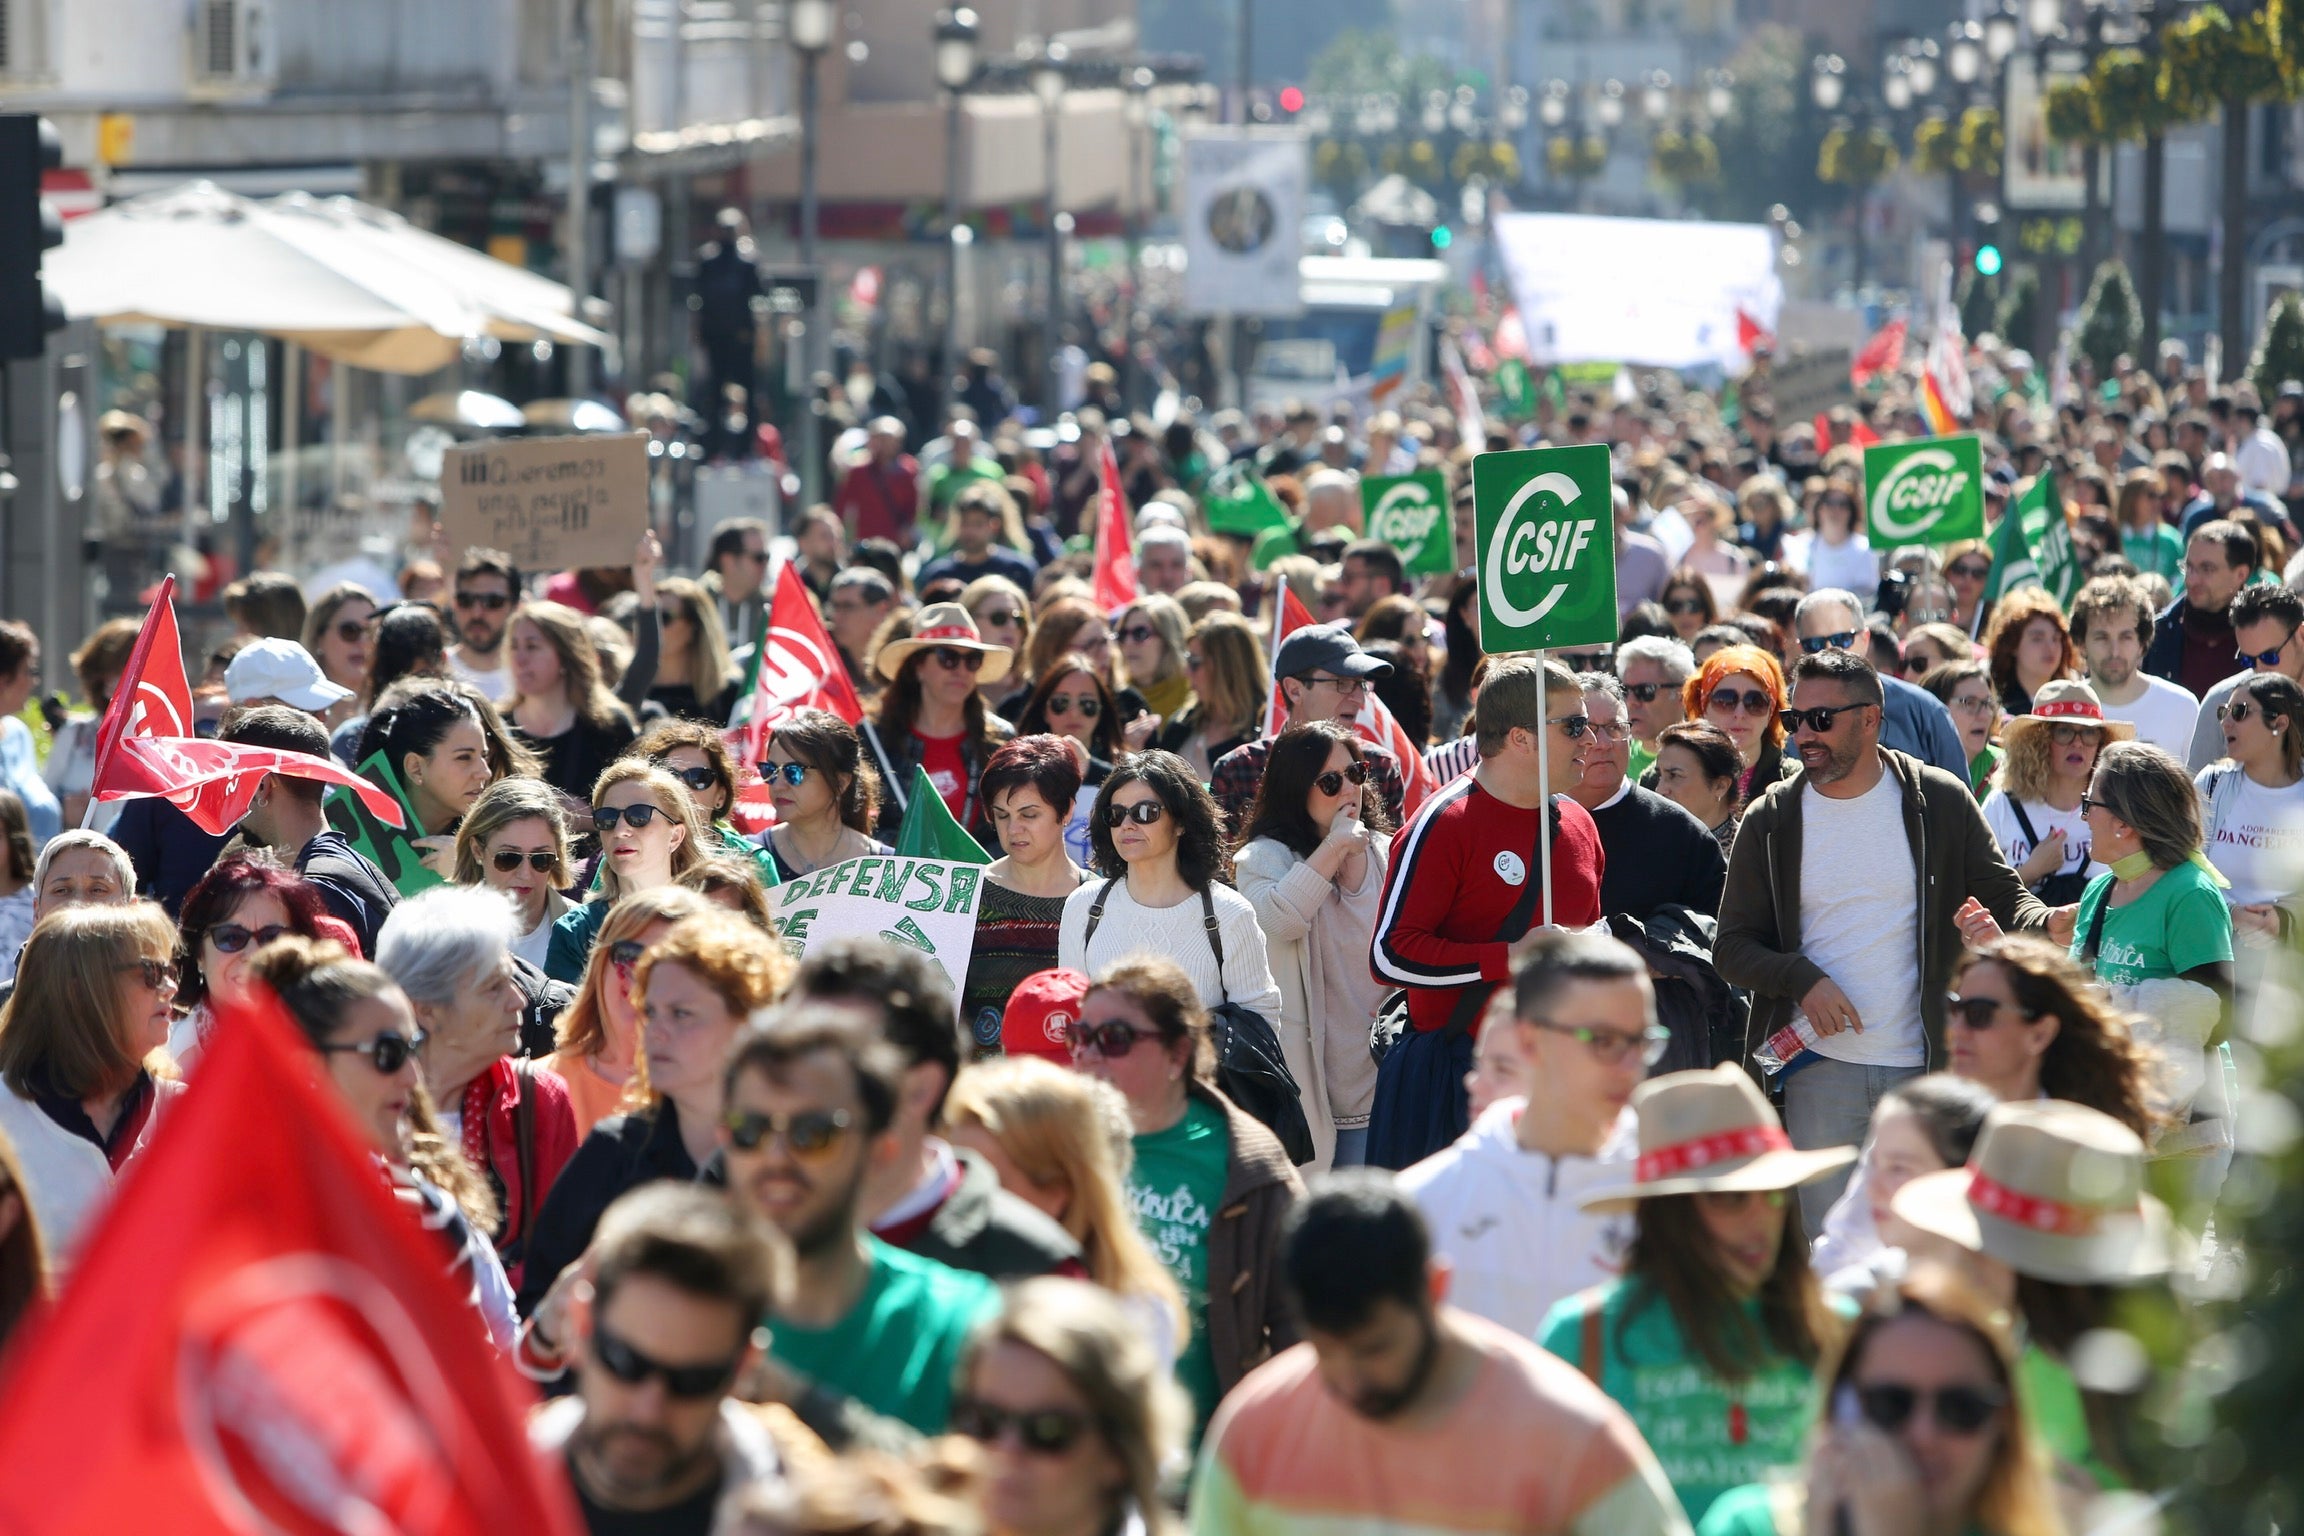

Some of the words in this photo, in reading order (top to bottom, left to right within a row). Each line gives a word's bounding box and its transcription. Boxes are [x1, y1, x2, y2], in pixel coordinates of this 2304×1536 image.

[1890, 471, 1968, 511] CSIF
[1507, 518, 1597, 575] CSIF
[781, 858, 980, 914] DEFENSA
